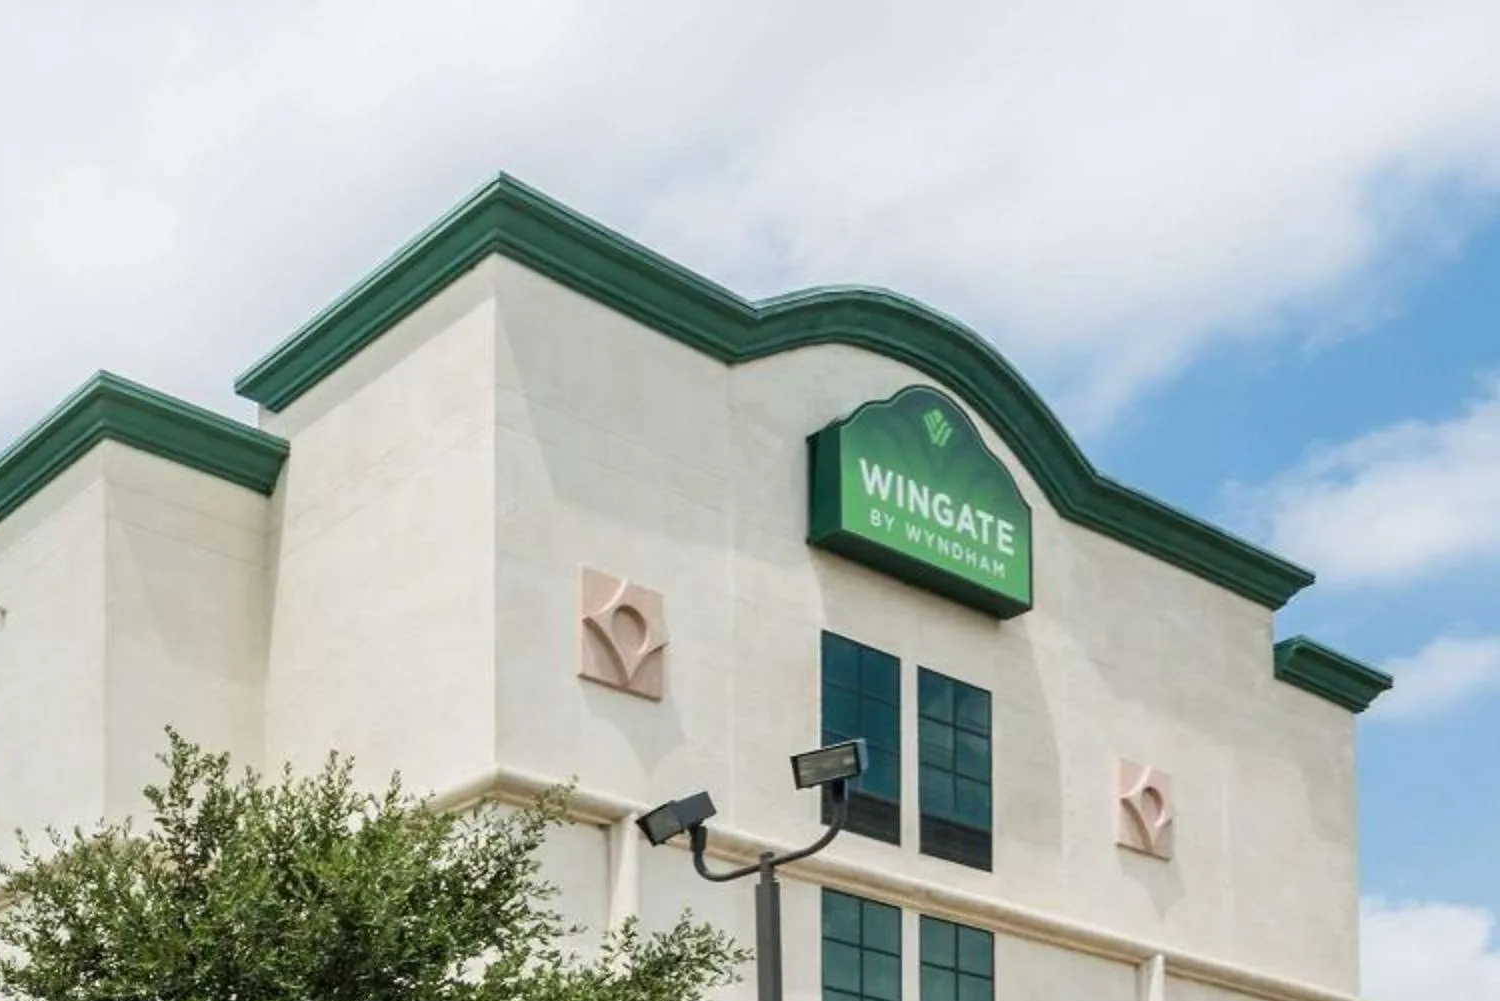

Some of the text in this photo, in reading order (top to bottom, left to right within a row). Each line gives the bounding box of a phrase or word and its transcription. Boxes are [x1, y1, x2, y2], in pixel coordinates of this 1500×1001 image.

[858, 457, 1015, 556] WINGATE
[870, 508, 1006, 579] BY WYNDHAM
